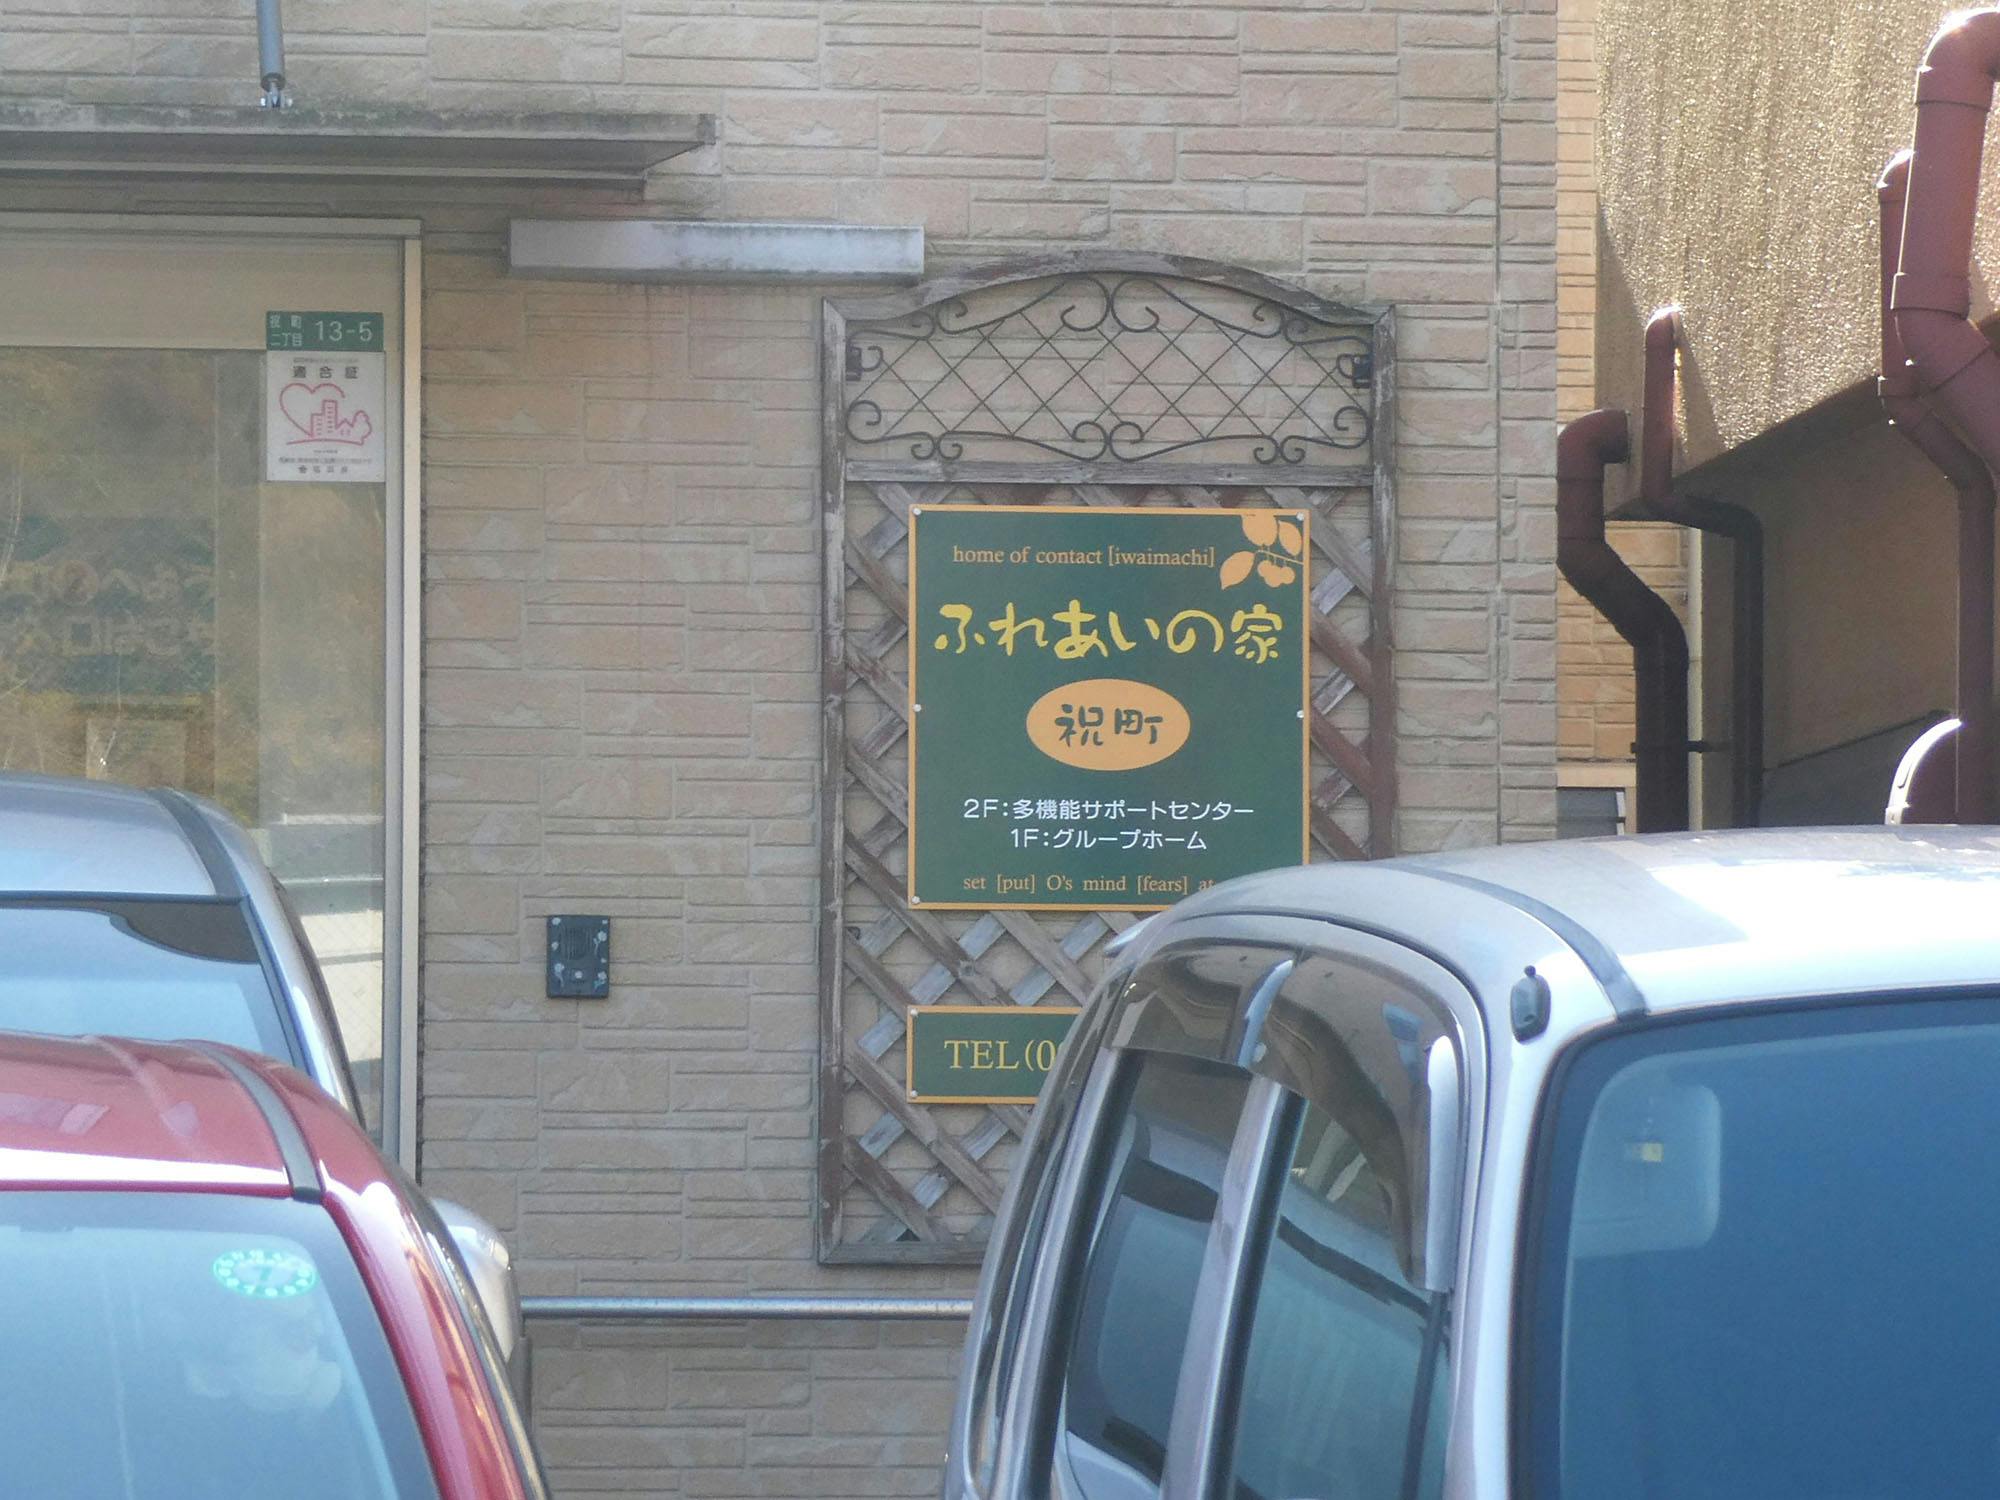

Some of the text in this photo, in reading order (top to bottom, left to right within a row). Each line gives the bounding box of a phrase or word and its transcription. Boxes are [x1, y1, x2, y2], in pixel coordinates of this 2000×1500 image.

[269, 332, 303, 347] 二丁目
[315, 320, 373, 342] 13-5
[952, 545, 1215, 569] home of contact [iwaimachi]
[934, 599, 1283, 665] ふれあいの家
[1054, 703, 1164, 747] 祝町
[963, 797, 1254, 821] 2F:多機能サポートセンター
[1010, 827, 1207, 851] 1F:グループホーム
[963, 875, 986, 891] set
[997, 873, 1036, 895] [put]
[1046, 874, 1073, 891] O's
[1082, 874, 1126, 892] mind
[1137, 875, 1188, 895] [fears]
